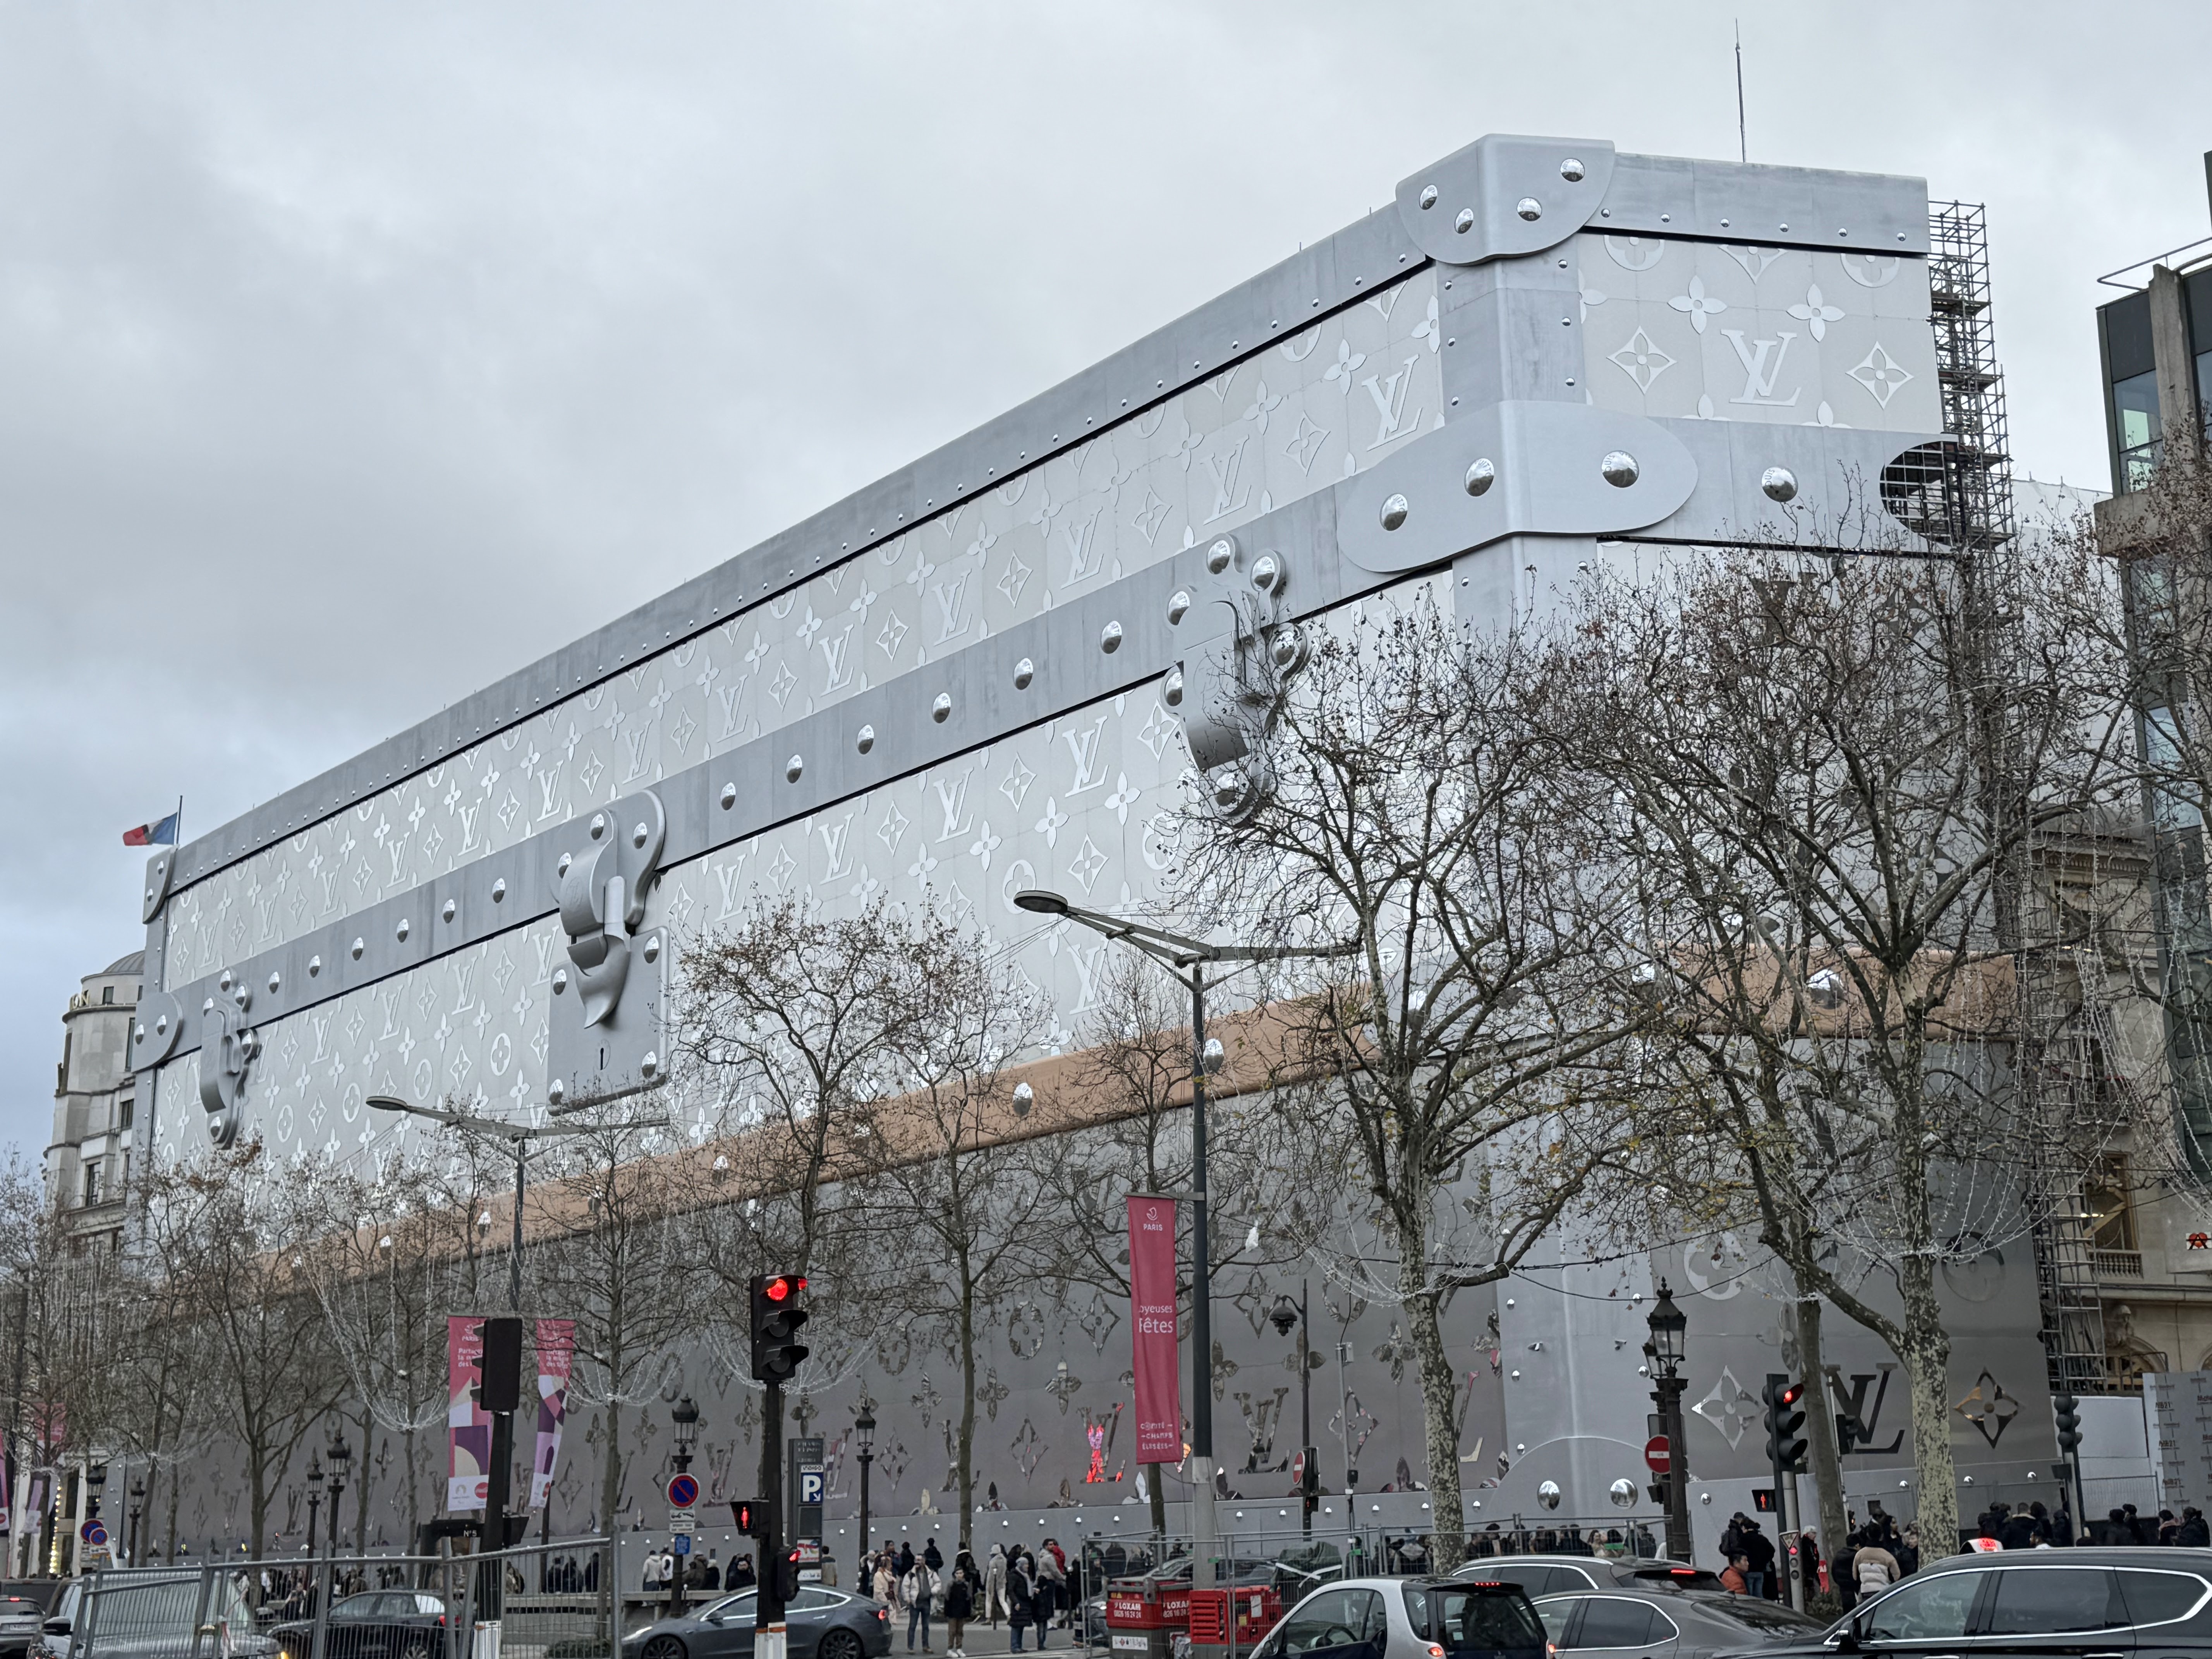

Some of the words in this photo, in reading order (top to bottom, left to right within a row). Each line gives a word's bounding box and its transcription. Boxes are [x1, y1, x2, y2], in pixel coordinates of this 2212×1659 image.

[1361, 354, 1423, 452] LV
[1720, 329, 1802, 407] LV
[819, 623, 854, 697] LV
[536, 759, 564, 823] LV
[1062, 715, 1109, 798] LV
[457, 797, 483, 857] LV
[933, 767, 974, 843] LV
[819, 812, 854, 885] LV
[713, 853, 747, 922] LV
[1143, 1223, 1163, 1231] PARIS
[1139, 1305, 1173, 1315] oyeuses
[1077, 1402, 1126, 1484] LV
[1233, 1387, 1290, 1474] LV
[802, 1475, 821, 1502] P
[1119, 1602, 1141, 1611] LOXAM
